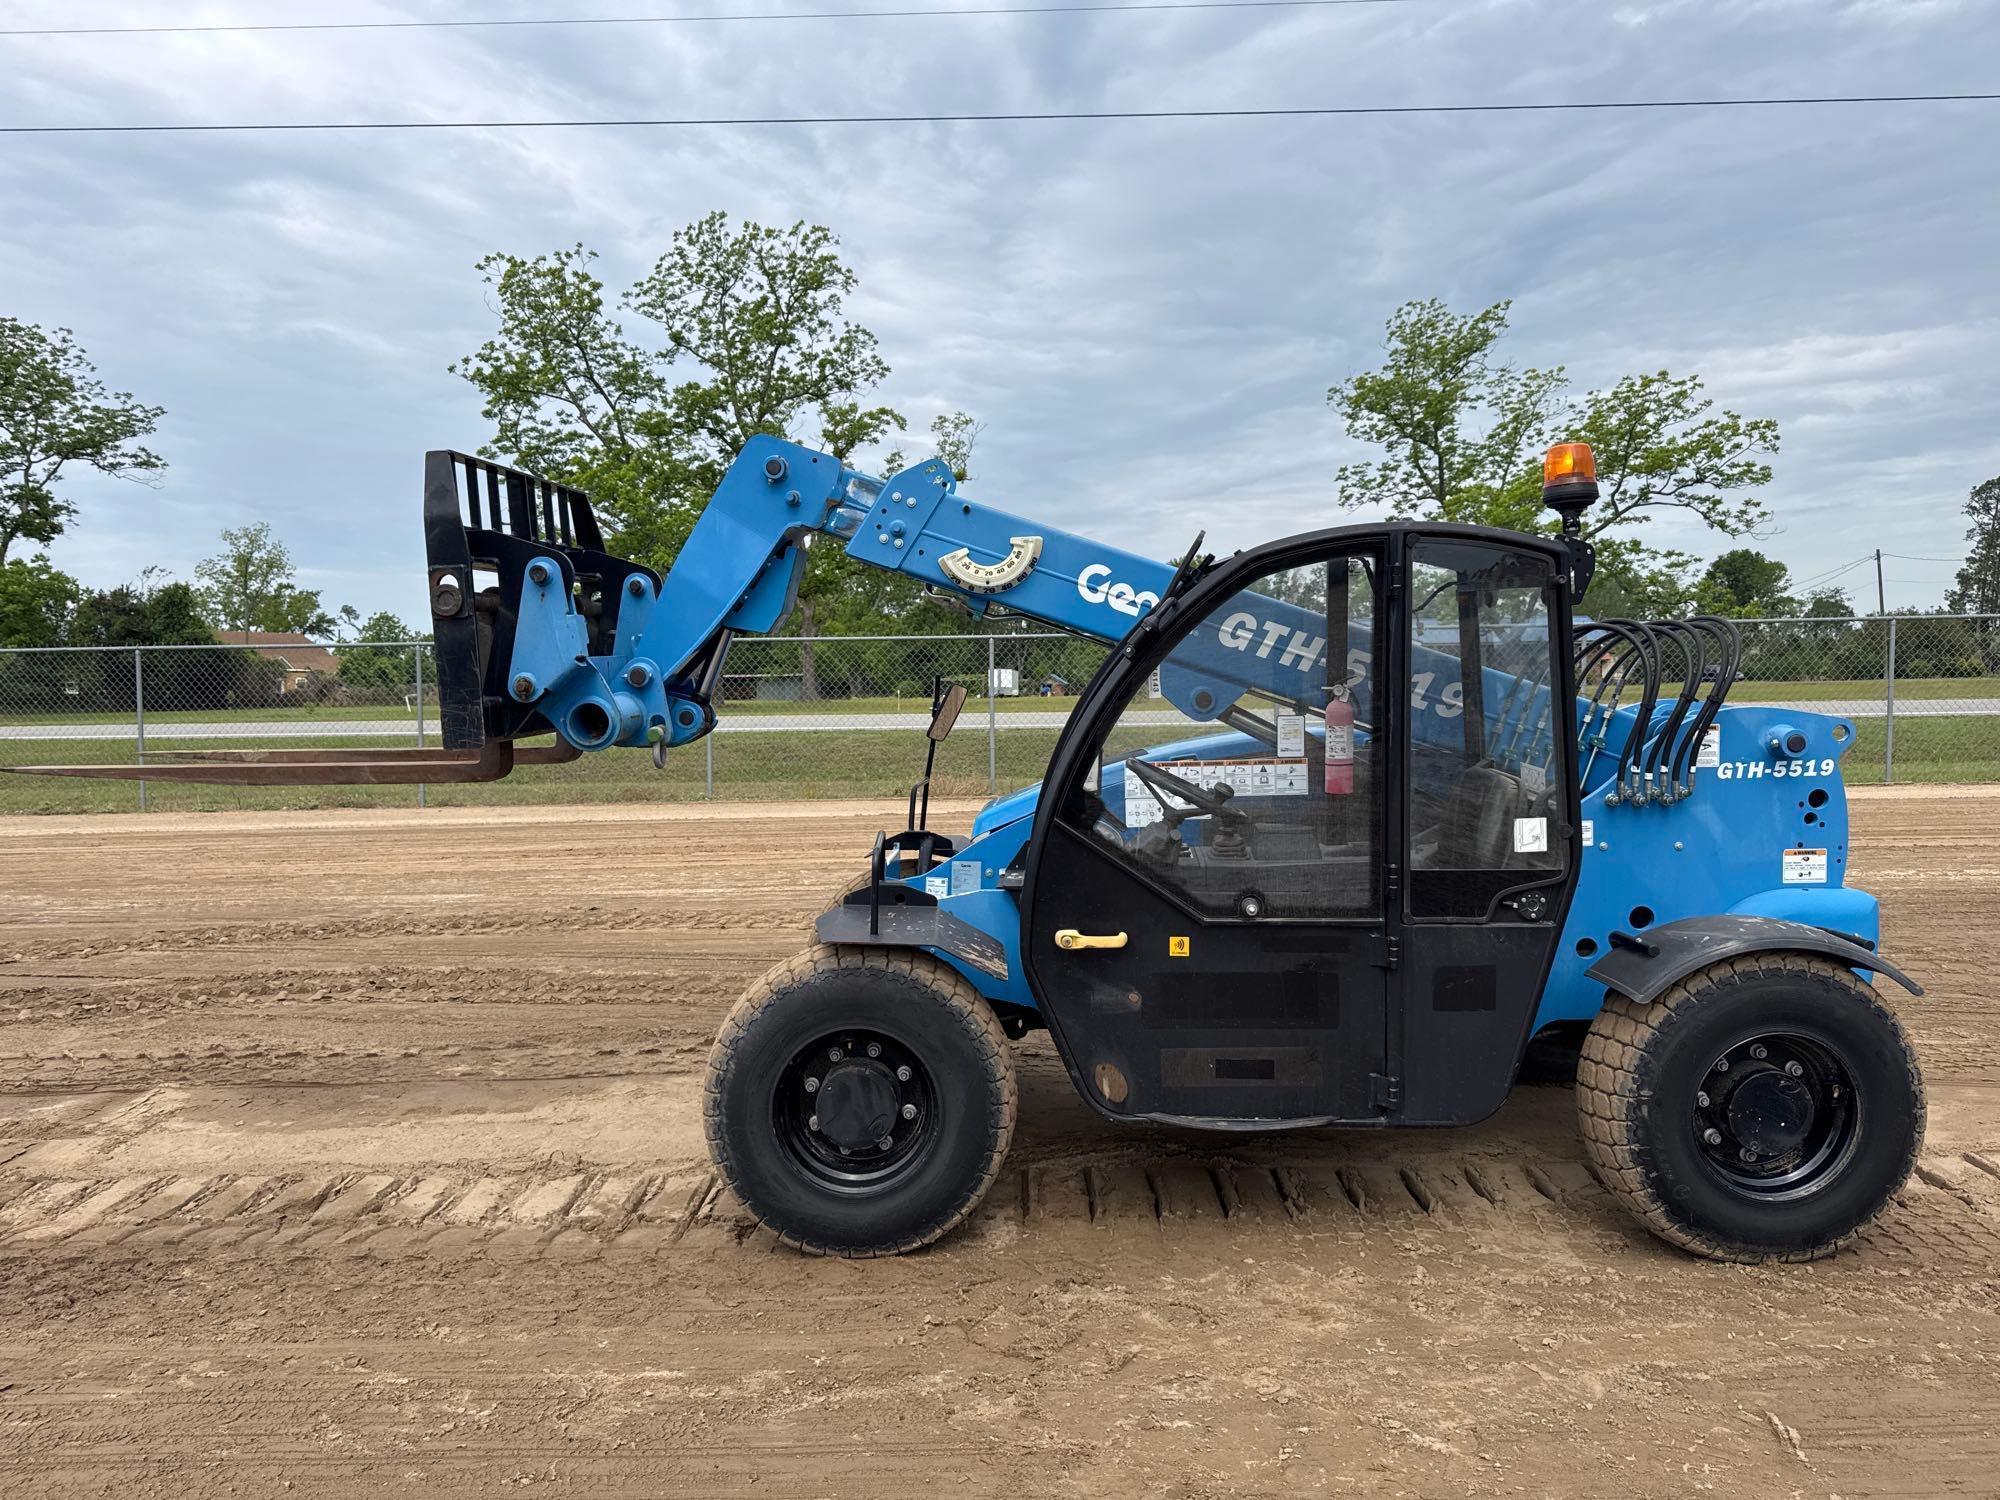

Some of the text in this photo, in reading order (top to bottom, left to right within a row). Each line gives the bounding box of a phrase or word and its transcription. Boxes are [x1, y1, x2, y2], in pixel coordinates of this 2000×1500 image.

[1015, 551, 1022, 559] 80
[1001, 582, 1013, 591] 40
[1016, 572, 1028, 583] 60
[1029, 557, 1038, 569] 80
[1717, 758, 1835, 779] GTH-5519
